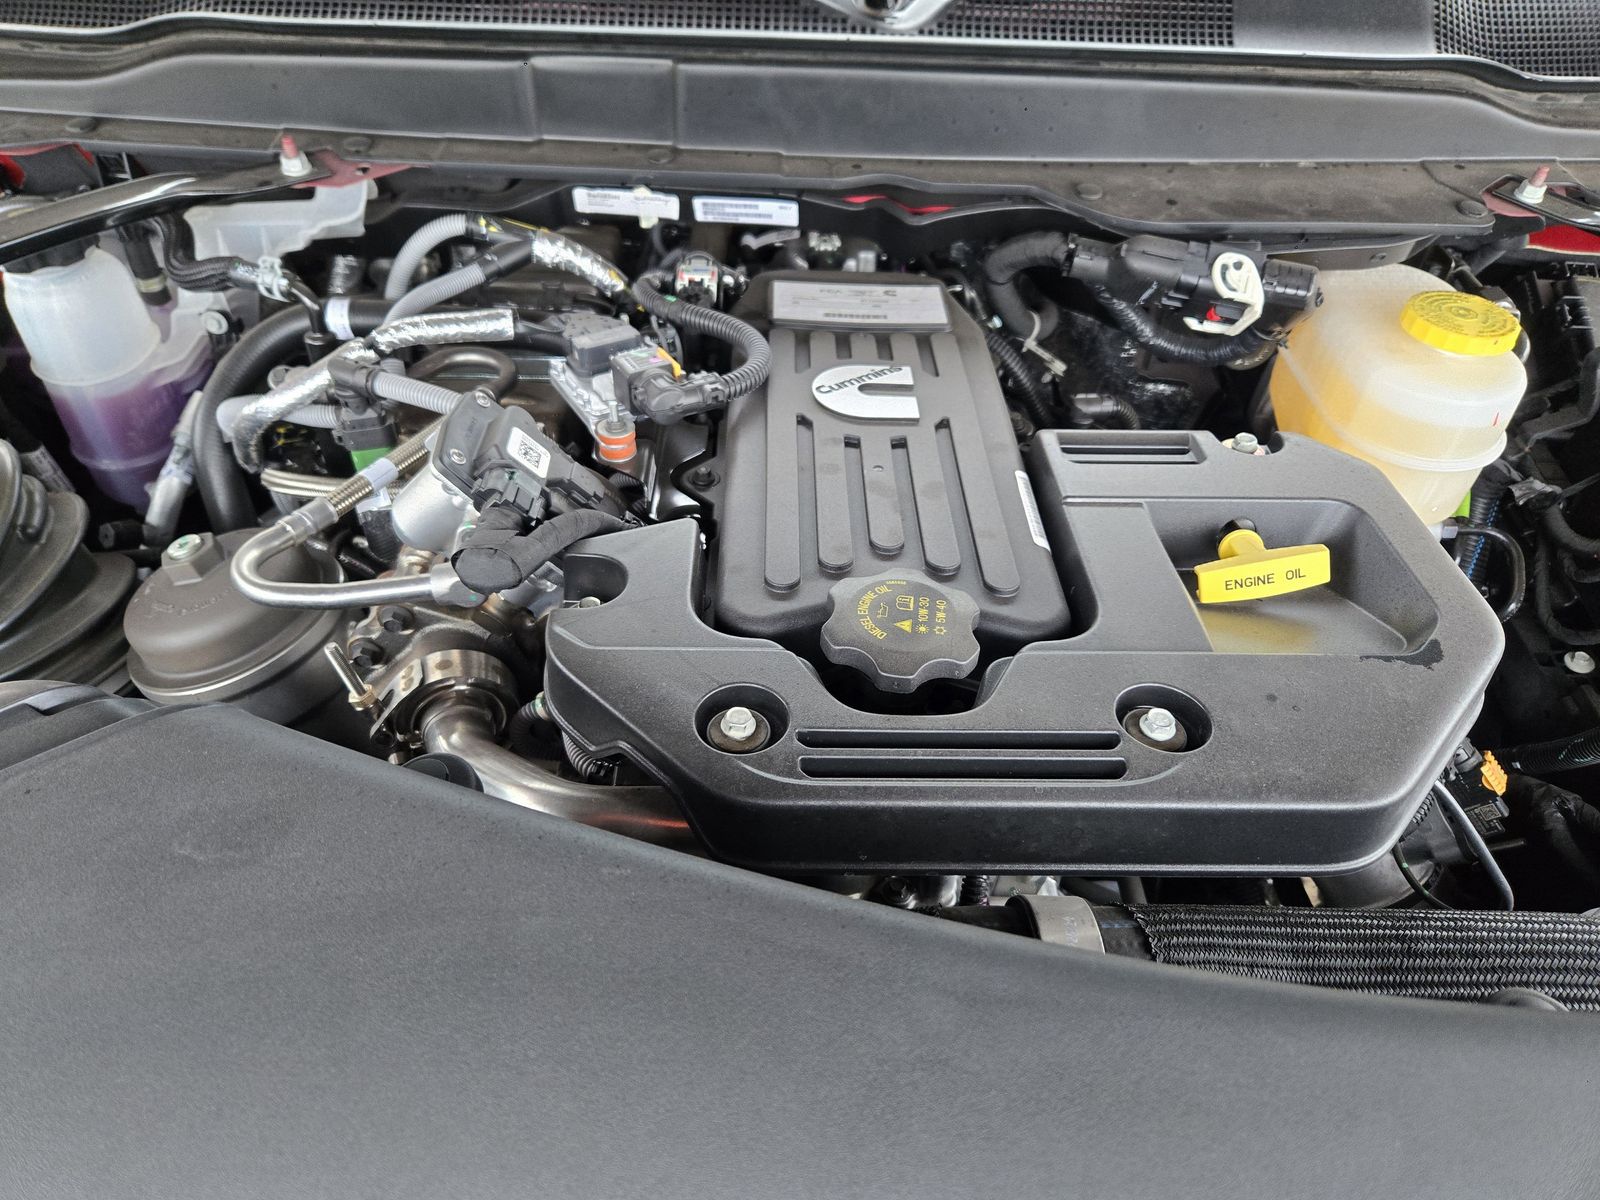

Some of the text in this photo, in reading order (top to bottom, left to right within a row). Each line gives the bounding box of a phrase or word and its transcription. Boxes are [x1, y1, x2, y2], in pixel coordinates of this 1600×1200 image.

[815, 366, 903, 394] Cummins
[1225, 568, 1306, 591] ENGINE OIL
[857, 584, 893, 640] DIESEL ENGINE OIL
[919, 597, 930, 622] 10W-30
[936, 600, 946, 623] 5W-40
